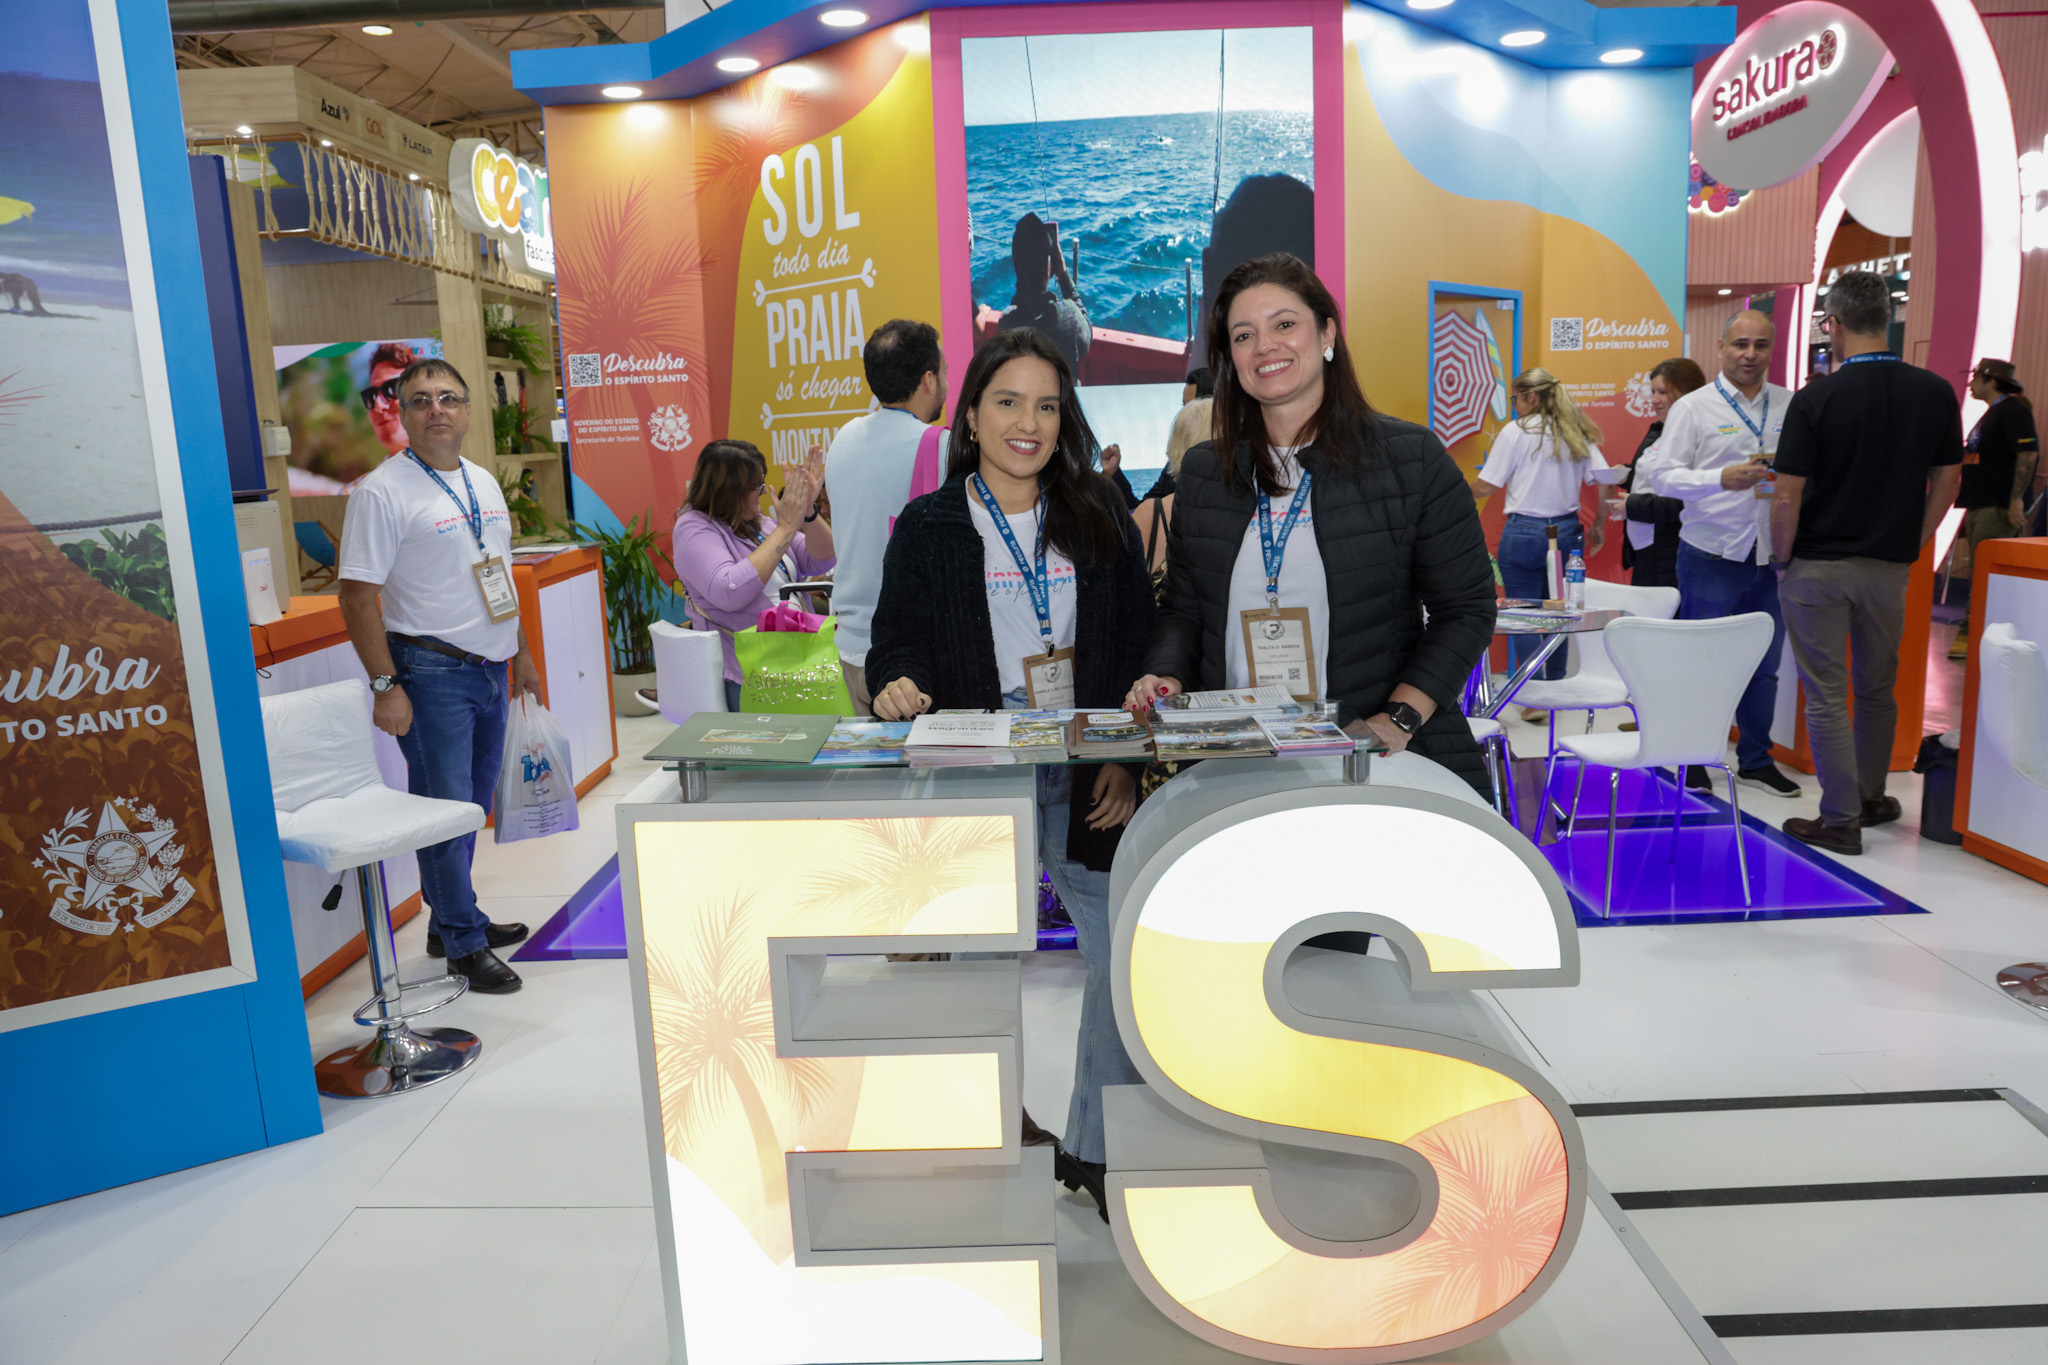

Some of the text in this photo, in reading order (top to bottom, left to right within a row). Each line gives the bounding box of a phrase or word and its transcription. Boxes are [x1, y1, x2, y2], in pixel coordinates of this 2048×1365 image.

[1712, 41, 1815, 122] sakura
[321, 98, 341, 120] Azul
[366, 117, 385, 140] GOL
[408, 139, 433, 157] LATAM
[760, 135, 861, 246] SOL
[773, 236, 851, 279] todo dia
[765, 287, 866, 369] PRAIA
[1585, 317, 1670, 338] Descubra
[1585, 339, 1670, 350] O ESPÍRITO SANTO
[603, 351, 688, 373] Descubra
[604, 373, 690, 386] O ESPÍRITO SANTO
[775, 365, 862, 410] só chegar
[1591, 400, 1616, 408] Turismo
[573, 417, 639, 427] GOVERNO DO ESTADO
[578, 424, 640, 434] DO ESPÍRITO SANTO
[575, 436, 606, 444] Secretaria
[0, 643, 161, 704] ubra
[743, 666, 839, 691] Valentina
[796, 686, 835, 703] STYLE
[55, 704, 168, 737] SANTO
[69, 918, 85, 929] MAIO
